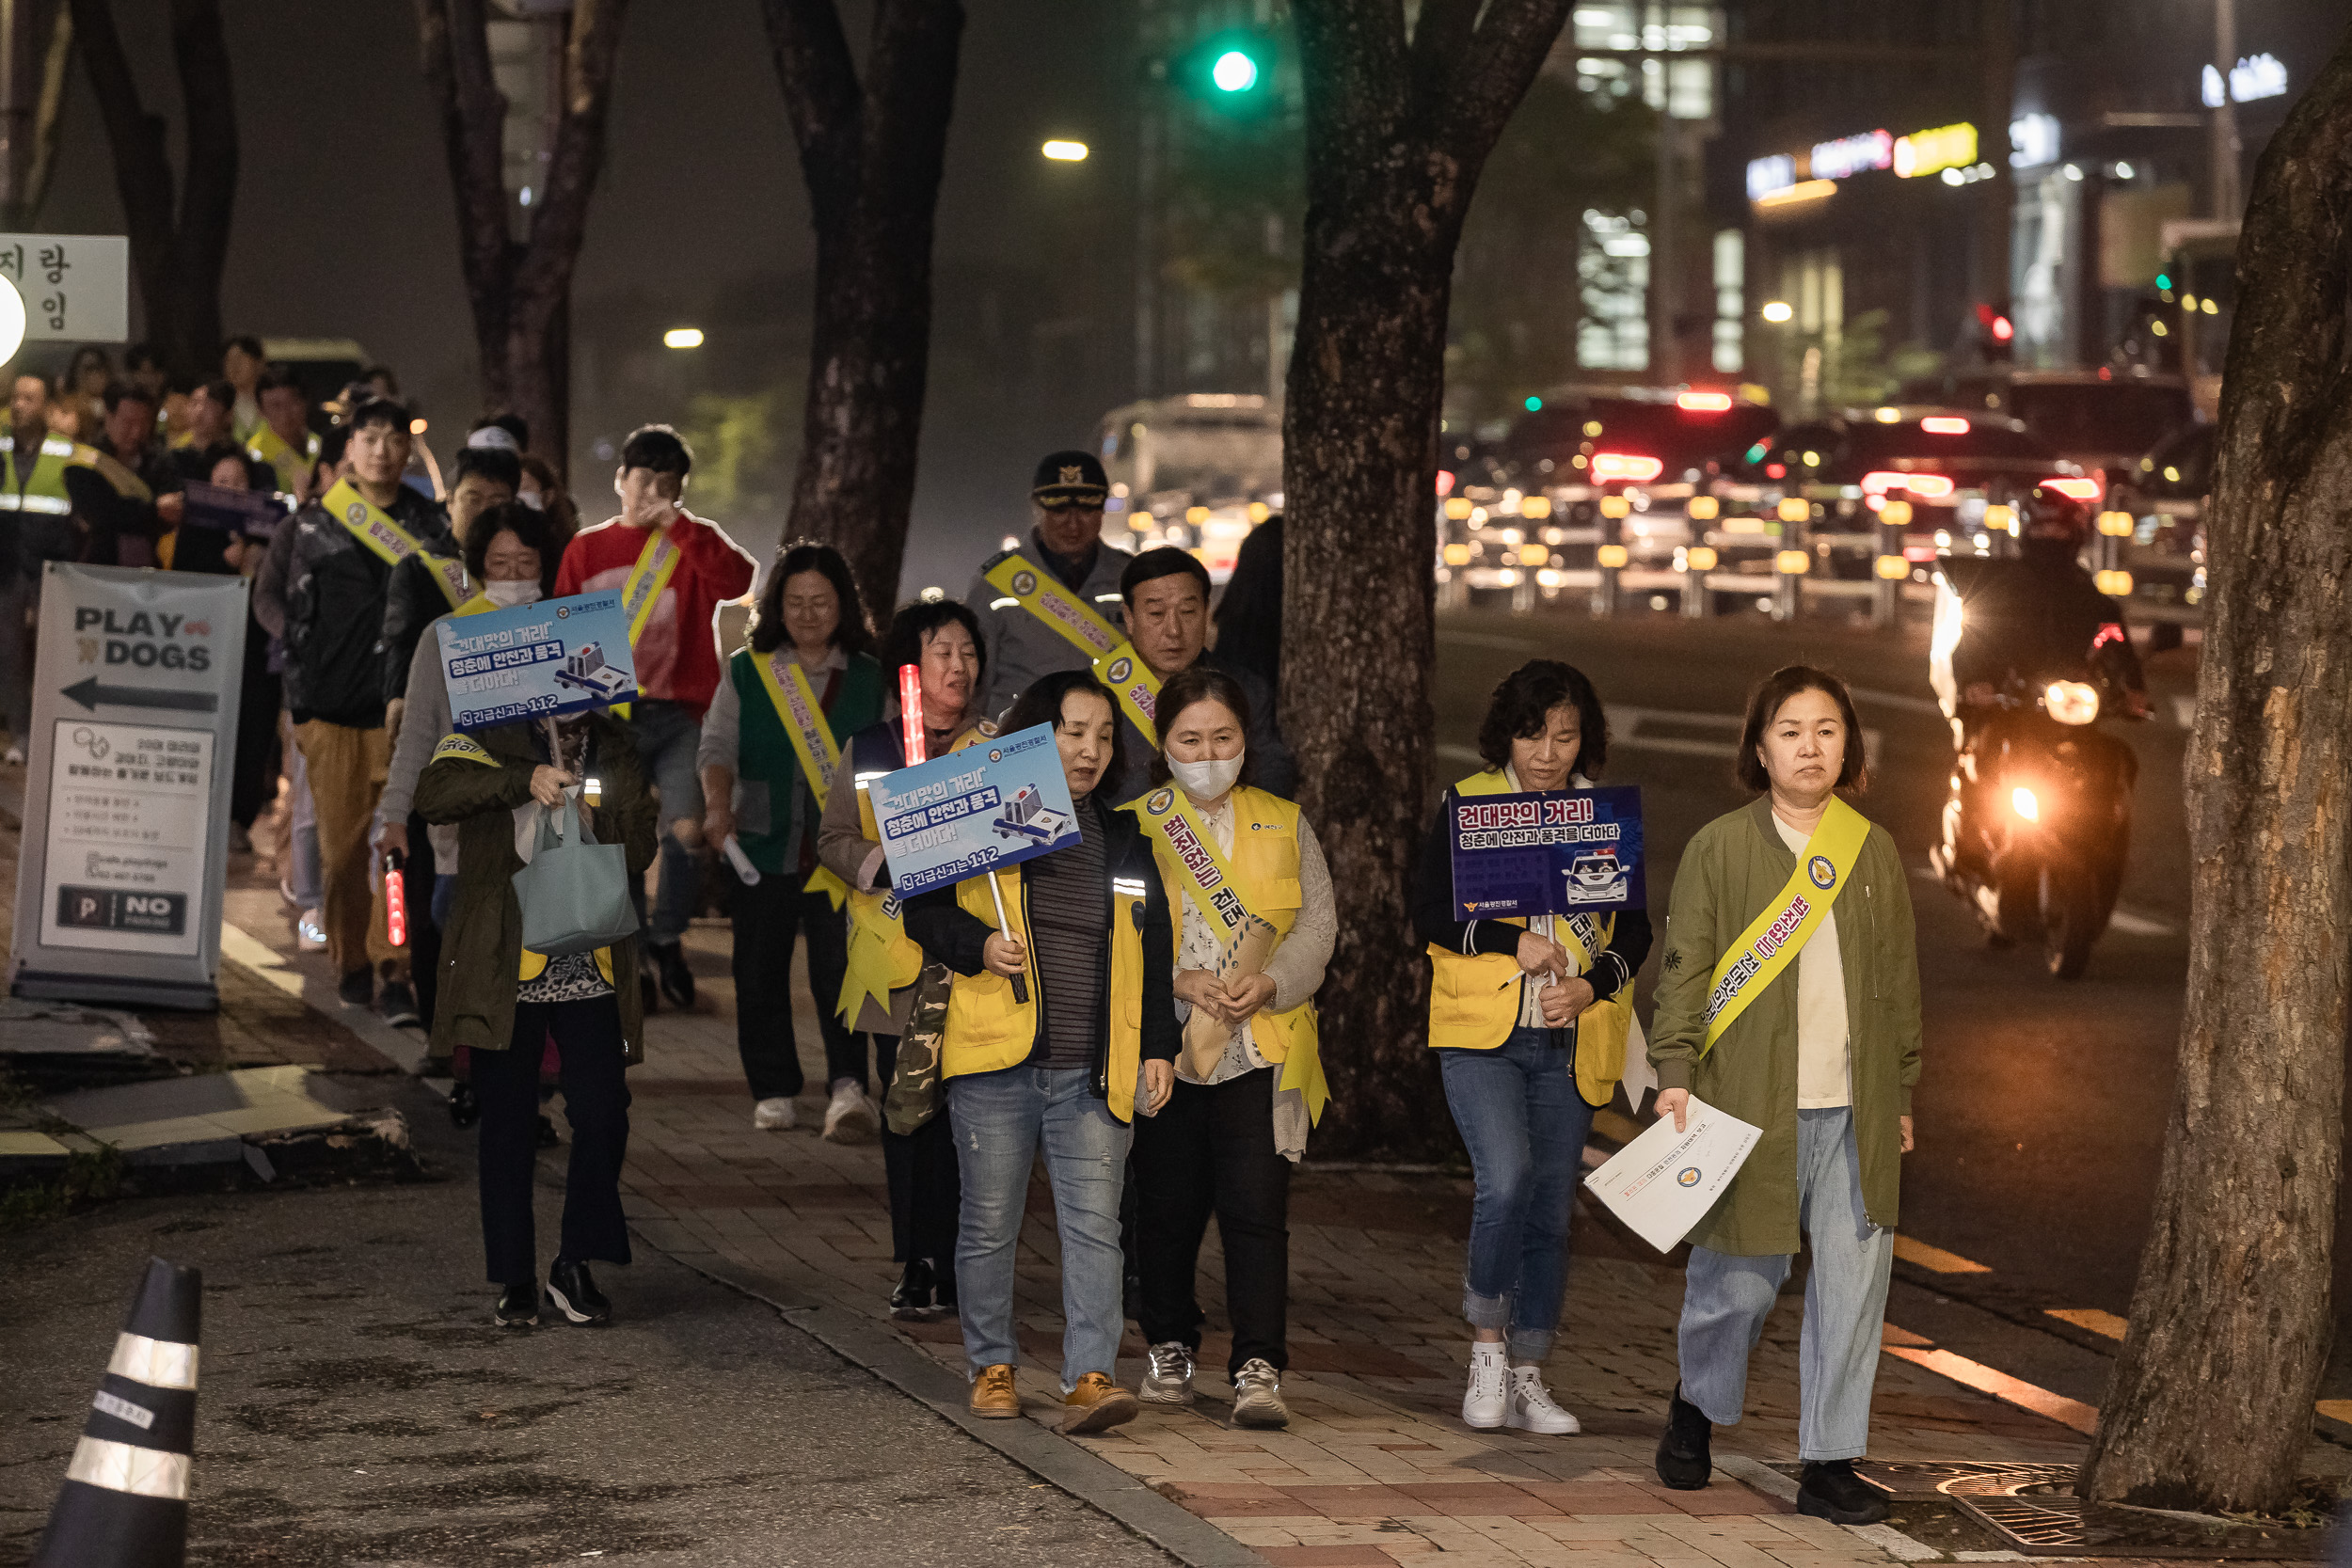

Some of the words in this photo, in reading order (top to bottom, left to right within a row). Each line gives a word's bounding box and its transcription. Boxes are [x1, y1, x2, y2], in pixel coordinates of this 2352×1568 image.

[74, 606, 183, 638] PLAY
[104, 641, 212, 672] DOGS
[451, 657, 492, 676] 청춘에
[494, 650, 533, 668] 안전과
[535, 644, 561, 660] 품격
[473, 704, 528, 722] 긴급신고는
[530, 696, 558, 711] 112
[1003, 735, 1047, 753] 서울광진경찰서
[886, 813, 927, 838] 청춘에
[929, 800, 969, 822] 안전과
[970, 789, 998, 810] 품격
[1458, 801, 1541, 830] 건대맛의
[1544, 799, 1594, 825] 거리!
[1163, 813, 1223, 890] 범죄없는
[1460, 832, 1499, 849] 청춘에
[1501, 830, 1539, 847] 안전과
[1541, 827, 1580, 844] 품격을
[1581, 824, 1620, 842] 더하다
[914, 860, 968, 886] 긴급신고는
[969, 847, 999, 867] 112
[125, 895, 171, 916] NO
[1479, 899, 1518, 908] 서울광진경찰서
[1754, 894, 1811, 959] 범죄없는
